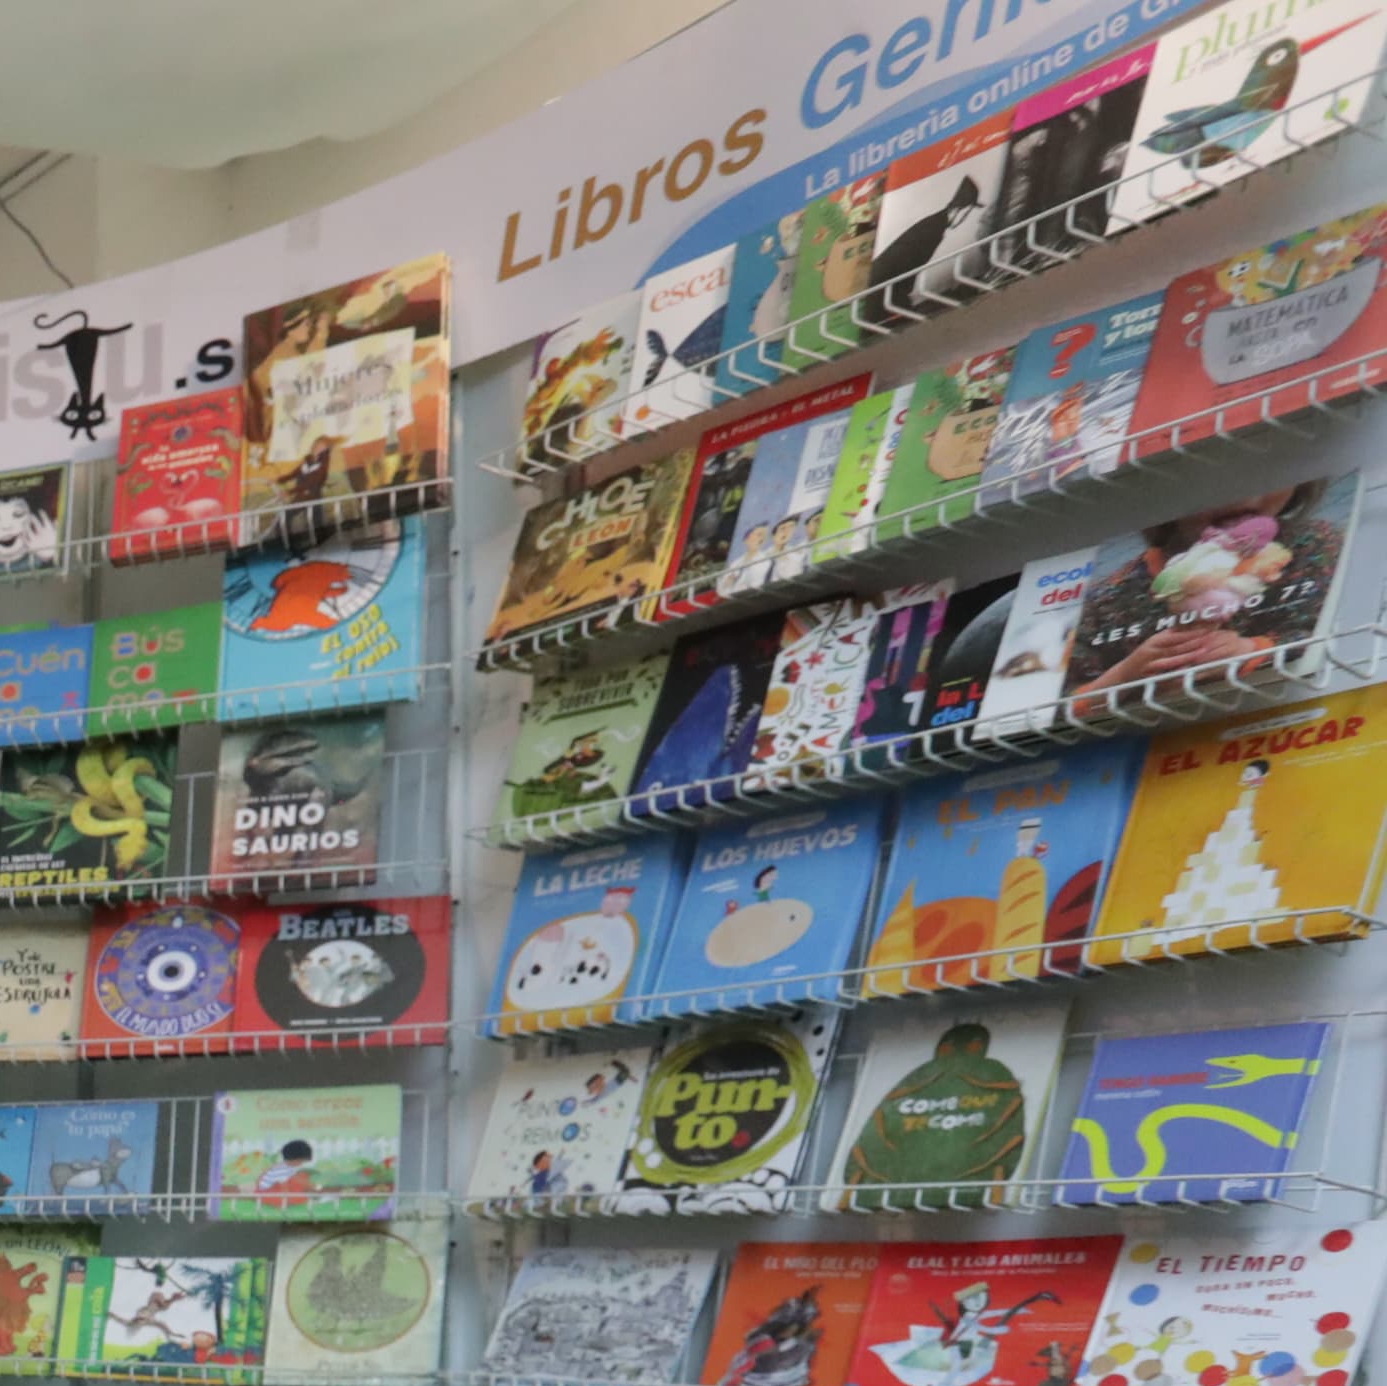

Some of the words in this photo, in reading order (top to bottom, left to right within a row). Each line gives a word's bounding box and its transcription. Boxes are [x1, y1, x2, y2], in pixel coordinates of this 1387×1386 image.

[800, 0, 1052, 130] Gen
[805, 164, 841, 200] La
[967, 35, 1074, 115] online
[1083, 1, 1131, 51] de
[497, 106, 769, 283] Libros
[1041, 583, 1082, 606] del
[1157, 594, 1265, 633] MUCHO
[931, 701, 974, 728] del
[1160, 752, 1202, 777] EL
[1217, 715, 1366, 767] AZÚCAR
[235, 802, 325, 832] DINO
[938, 799, 981, 826] EL
[992, 781, 1071, 814] PAN
[231, 829, 360, 857] SAURIOS
[702, 847, 748, 873] LOS
[755, 824, 858, 861] HUEVOS
[534, 873, 562, 900] LA
[567, 856, 644, 893] LECHE
[278, 914, 410, 942] BEATLES
[1155, 1257, 1182, 1275] EL
[1198, 1255, 1307, 1273] TIEMPO
